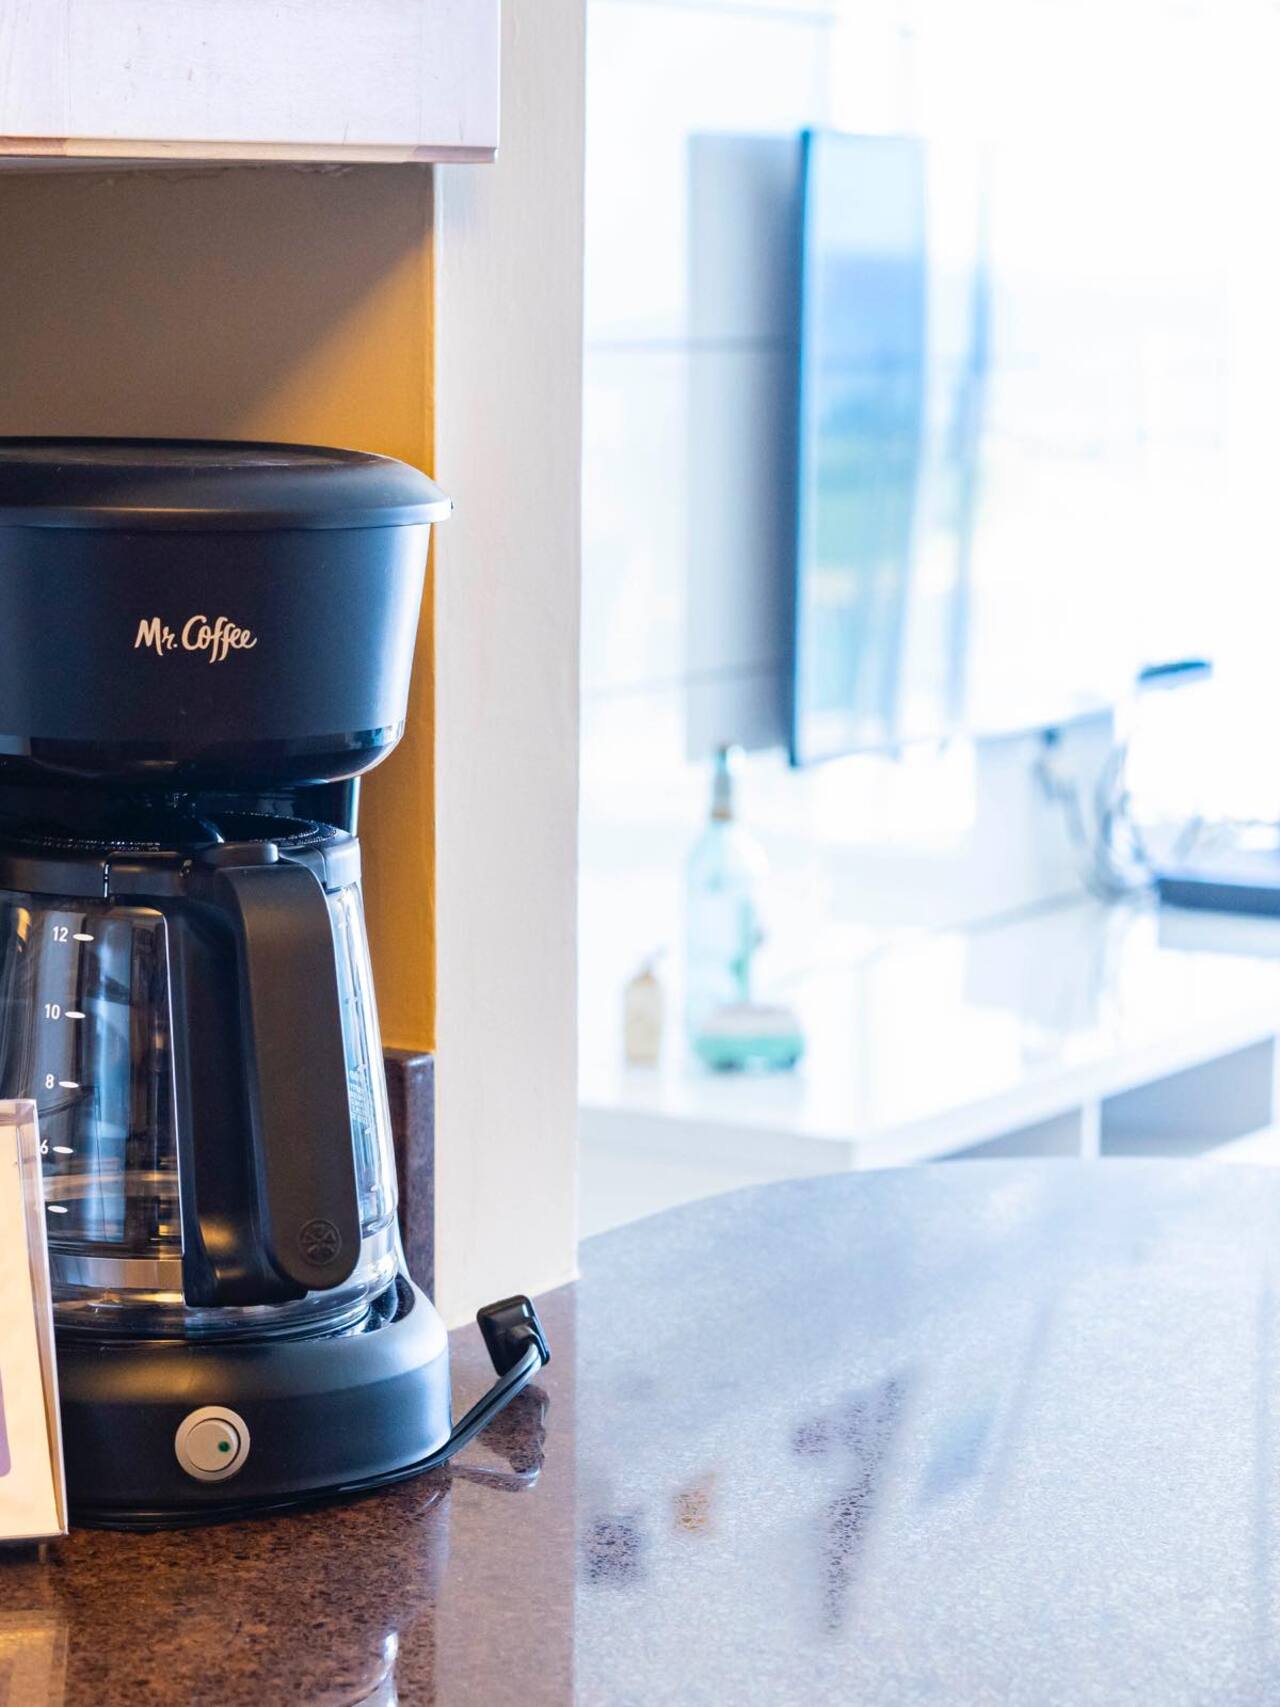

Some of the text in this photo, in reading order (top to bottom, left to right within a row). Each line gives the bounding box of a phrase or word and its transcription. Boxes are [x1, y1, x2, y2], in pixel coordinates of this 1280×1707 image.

[134, 615, 257, 664] Mr. Coffee
[53, 926, 68, 942] 12
[44, 1003, 61, 1020] 10
[45, 1074, 55, 1089] 8
[40, 1138, 49, 1155] 6
